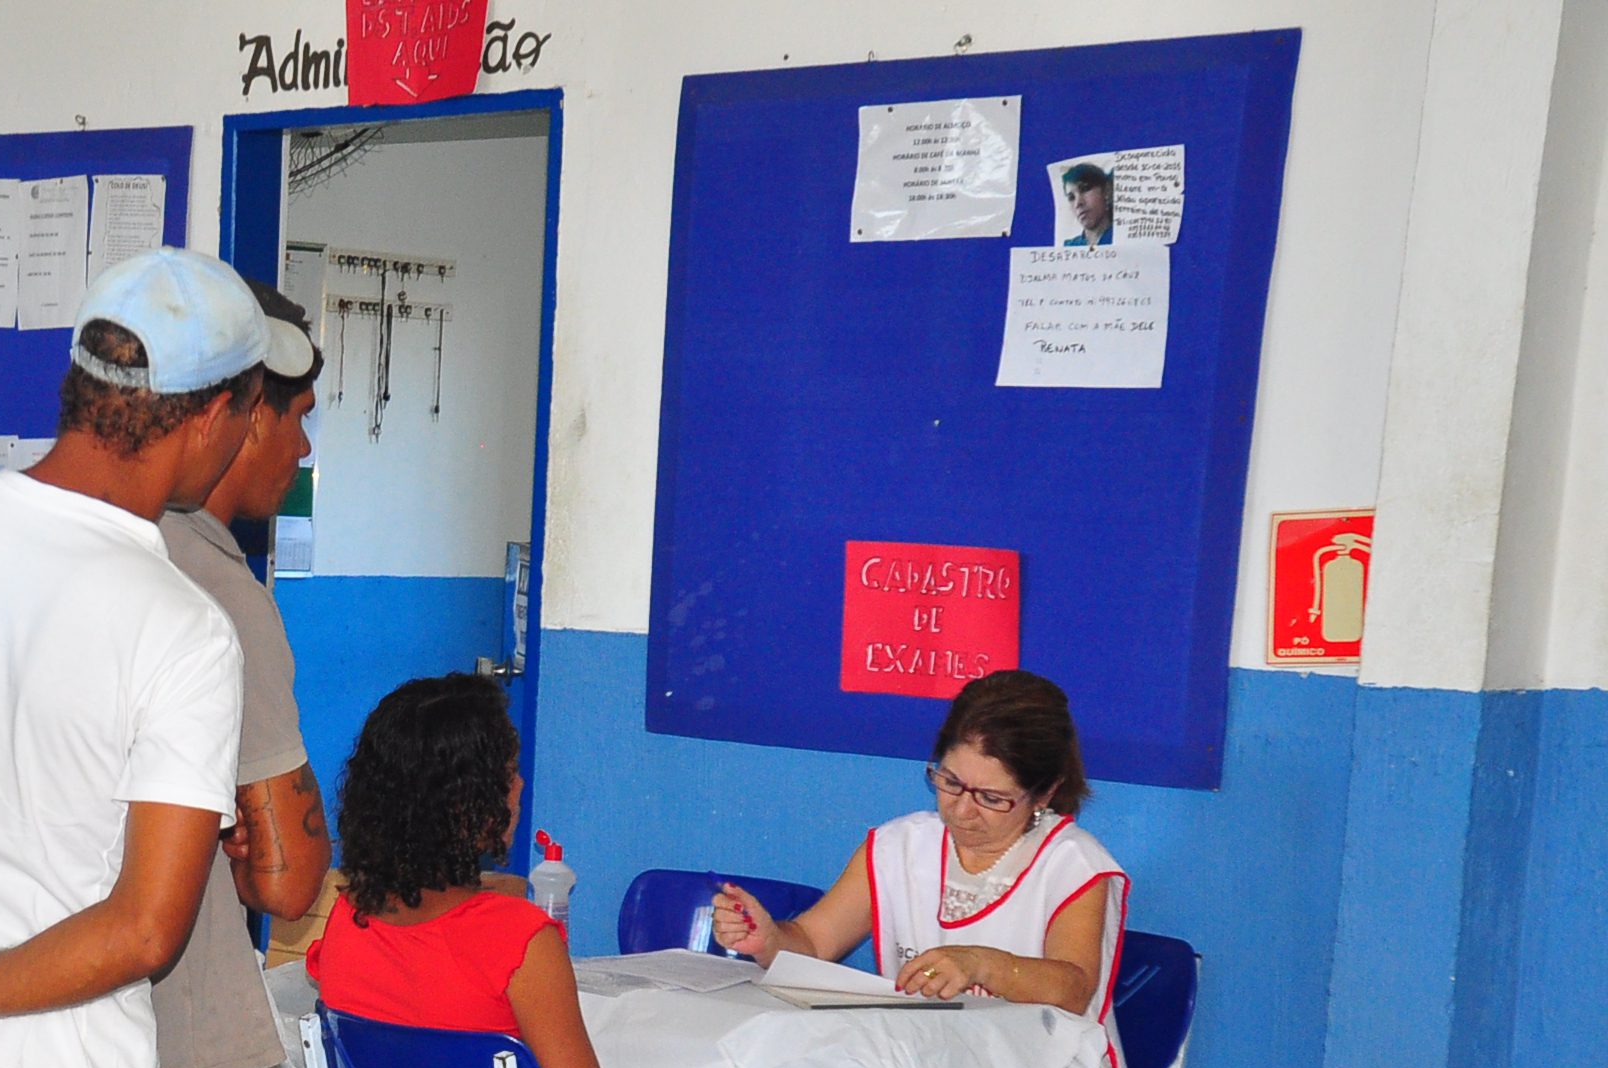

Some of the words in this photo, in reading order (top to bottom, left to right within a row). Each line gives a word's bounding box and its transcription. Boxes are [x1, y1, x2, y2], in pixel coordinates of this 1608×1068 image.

[391, 34, 449, 66] AQUI
[476, 16, 553, 76] ão
[943, 121, 972, 130] ALÇO
[929, 149, 945, 159] CAFÉ
[1033, 338, 1087, 354] RENATA
[860, 556, 1011, 600] CADASTRO
[912, 605, 945, 633] DE
[864, 642, 991, 680] EXAMES
